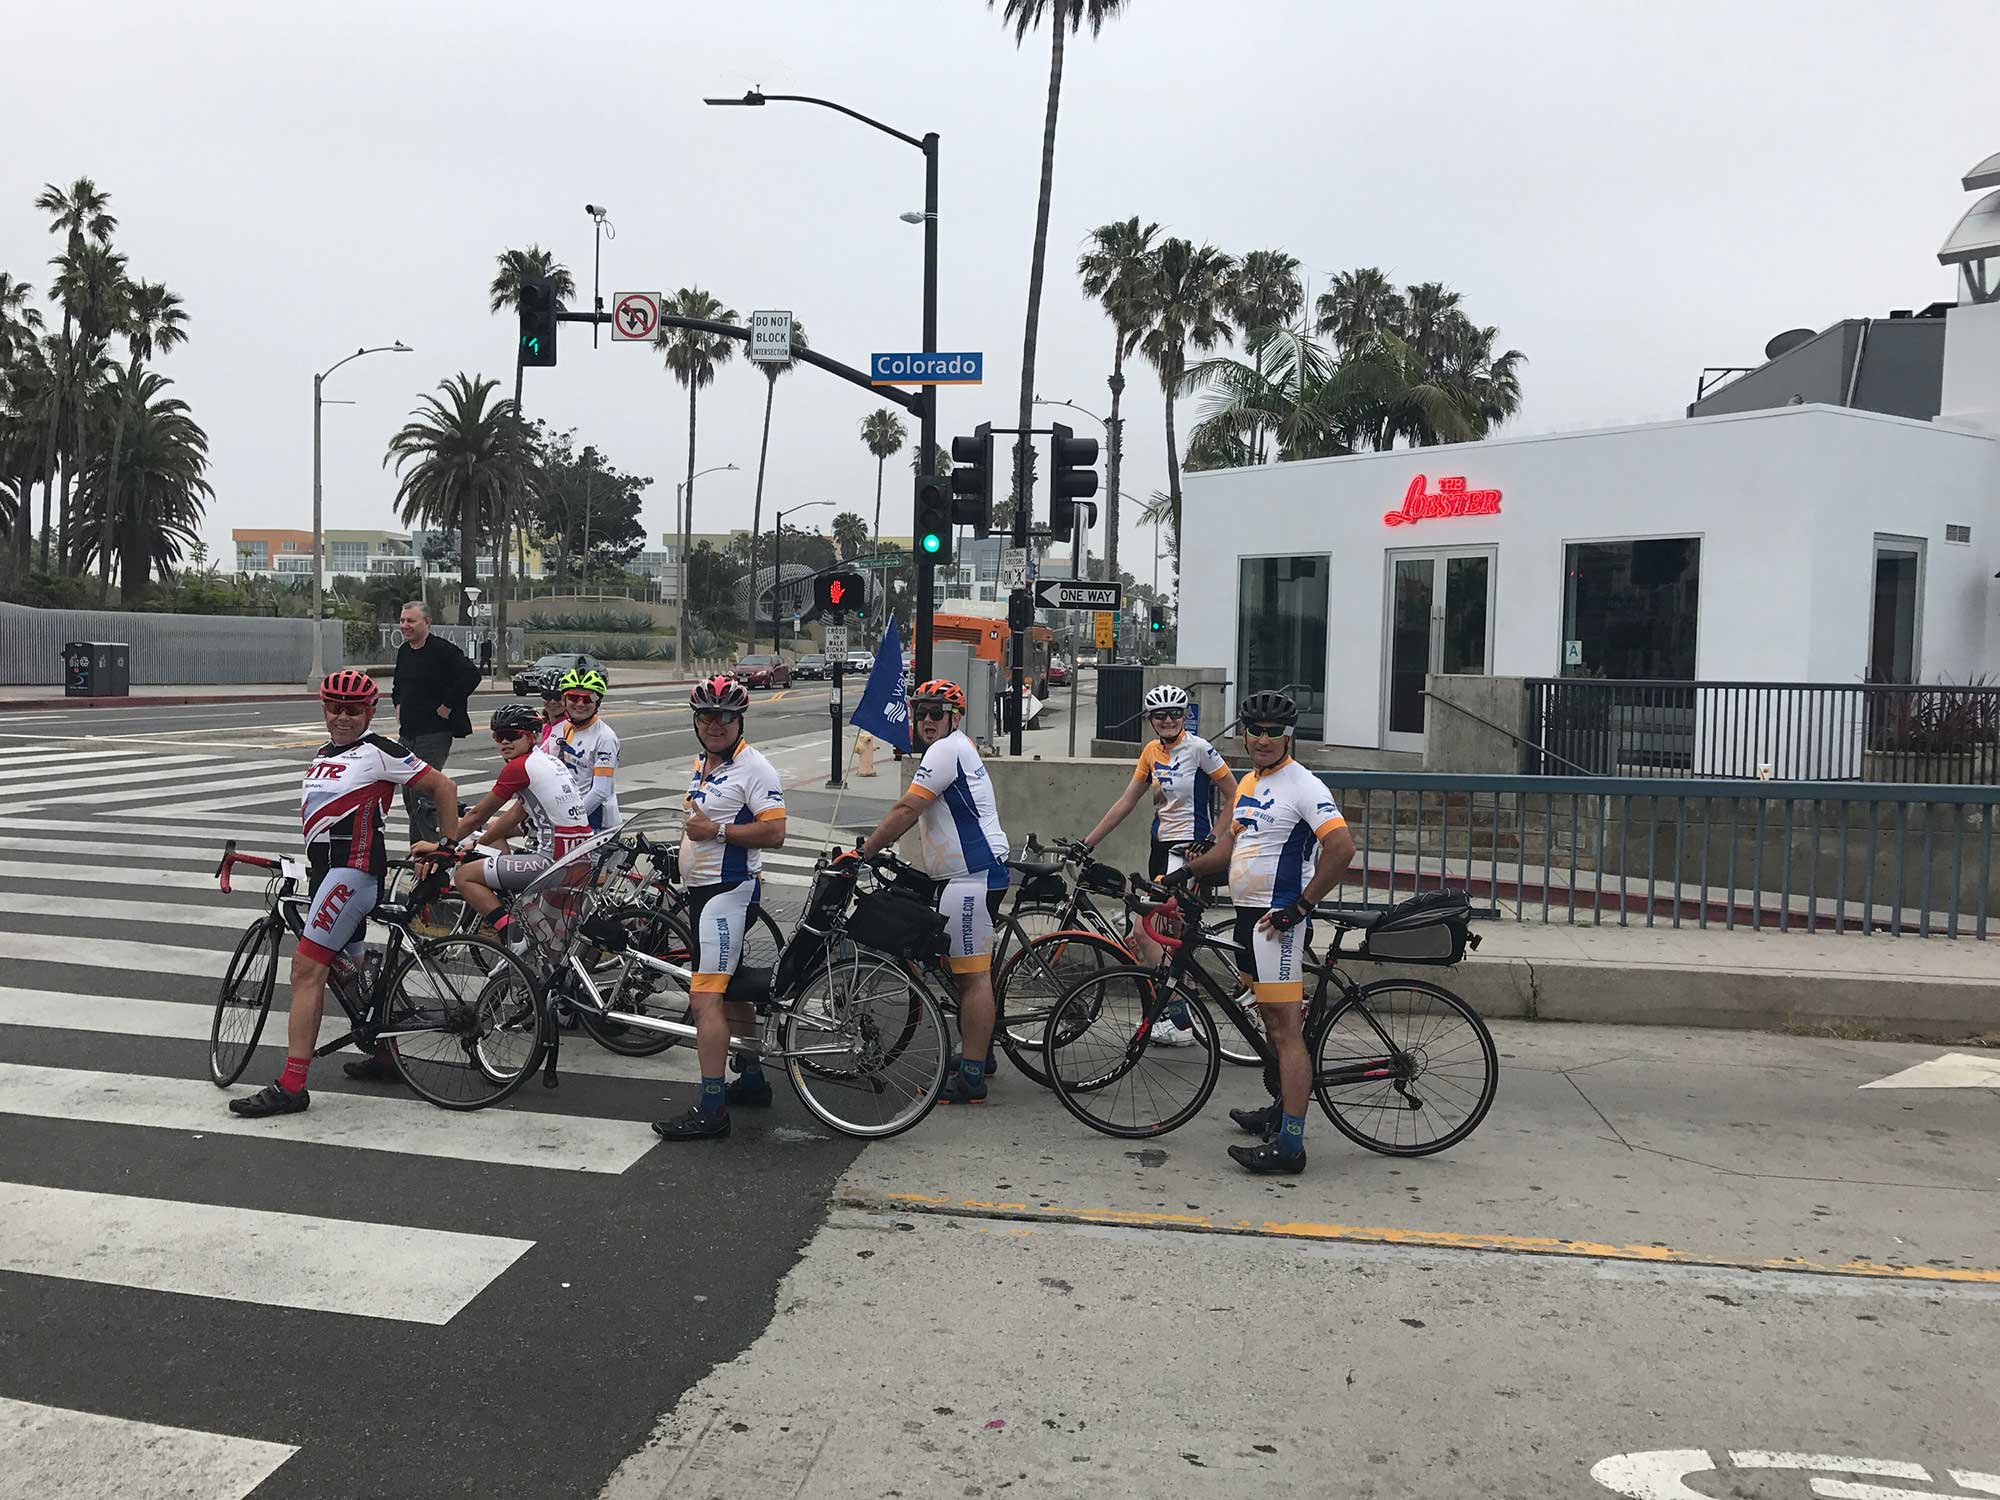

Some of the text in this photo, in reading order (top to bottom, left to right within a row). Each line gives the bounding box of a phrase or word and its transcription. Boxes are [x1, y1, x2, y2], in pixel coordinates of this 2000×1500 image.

[755, 316, 789, 327] DO NOT
[756, 333, 786, 343] BLOCK
[753, 348, 789, 357] INTERSECTION
[877, 355, 976, 375] Colorado
[1438, 476, 1466, 491] THE
[1060, 589, 1113, 603] ONE WAY
[990, 631, 998, 639] M
[1569, 644, 1578, 656] A
[1259, 812, 1275, 824] WATER
[503, 858, 549, 873] TEAM
[311, 883, 355, 932] WTR
[962, 895, 975, 956] SCOTTYSRIDE.COM
